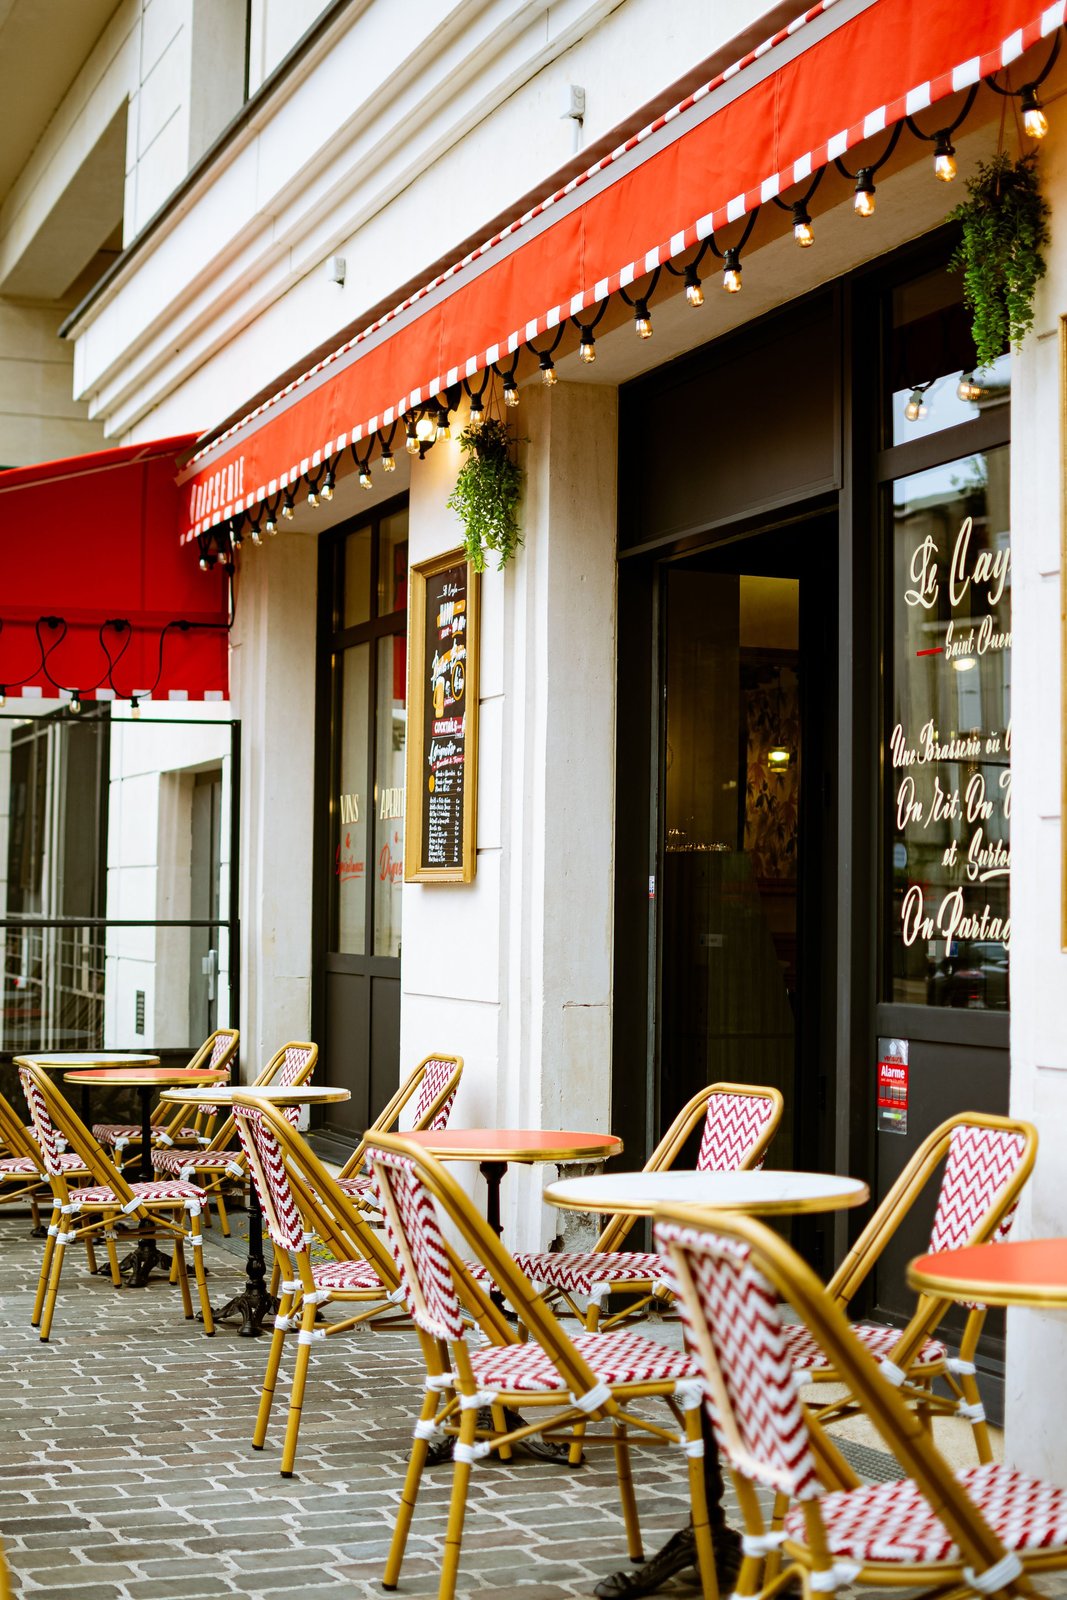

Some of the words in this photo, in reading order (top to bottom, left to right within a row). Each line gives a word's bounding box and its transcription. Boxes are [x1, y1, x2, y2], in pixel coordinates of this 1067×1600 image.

[904, 535, 939, 609] Le
[949, 516, 1012, 606] Cay
[945, 620, 975, 660] Saint
[890, 723, 916, 768] Une
[917, 718, 981, 764] Brasserie
[340, 793, 359, 825] VINS
[897, 776, 923, 830] On
[965, 773, 994, 823] On
[941, 839, 958, 867] et
[901, 885, 934, 946] On
[881, 1065, 905, 1079] Alarme
